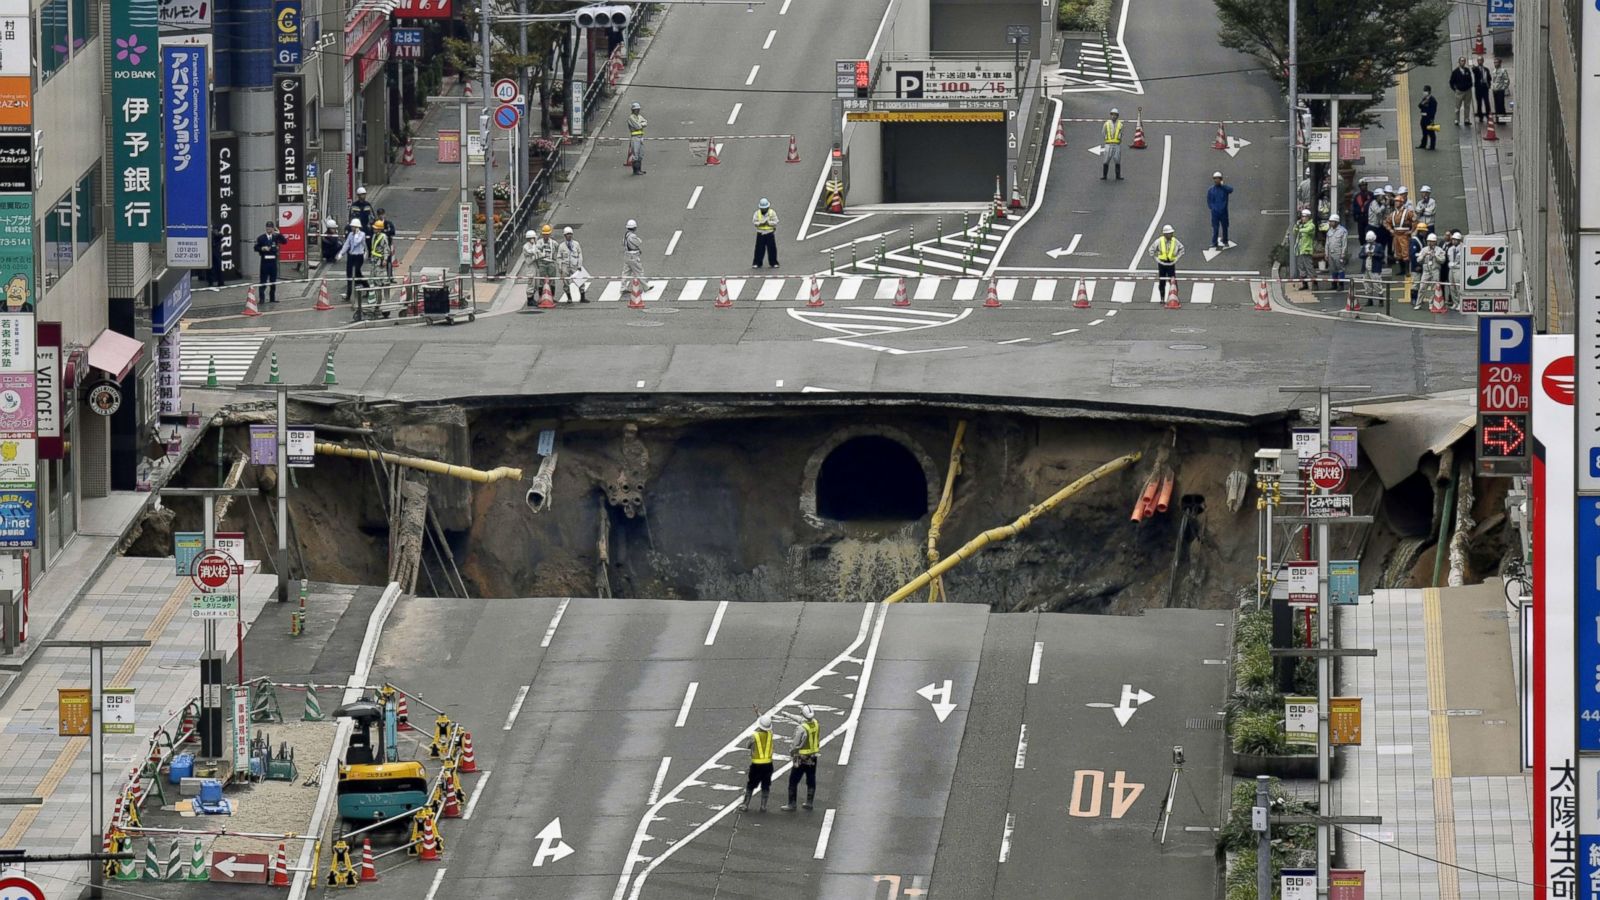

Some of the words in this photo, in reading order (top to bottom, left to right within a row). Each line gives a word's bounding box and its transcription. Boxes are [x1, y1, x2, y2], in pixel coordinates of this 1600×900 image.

[159, 5, 199, 20] ホルモン
[5, 20, 15, 40] 村田
[279, 50, 298, 63] 6F
[395, 45, 421, 57] ATM
[115, 71, 130, 79] IYO
[131, 71, 156, 79] BANK
[499, 86, 513, 98] 40
[901, 76, 920, 98] P
[171, 52, 192, 172] アパマンショップ
[192, 87, 200, 143] Communication
[283, 94, 296, 130] CAFÉ
[1009, 111, 1016, 120] P
[284, 133, 294, 144] de
[1008, 132, 1016, 148] 入口
[122, 97, 151, 227] 伊予銀行
[284, 148, 297, 182] CRIÉ
[220, 147, 233, 199] CAFÉ
[220, 203, 231, 219] de
[220, 223, 235, 272] CRIÉ
[1494, 300, 1508, 311] ATM
[1490, 319, 1524, 362] P
[1488, 366, 1522, 383] 20分
[1482, 384, 1529, 409] 100円
[1313, 467, 1341, 480] 消火栓
[1309, 497, 1351, 508] とみや歯科
[200, 564, 229, 578] 消火栓
[202, 595, 236, 603] むらつ歯科
[1068, 769, 1145, 819] 40
[1550, 758, 1575, 900] 太陽生命
